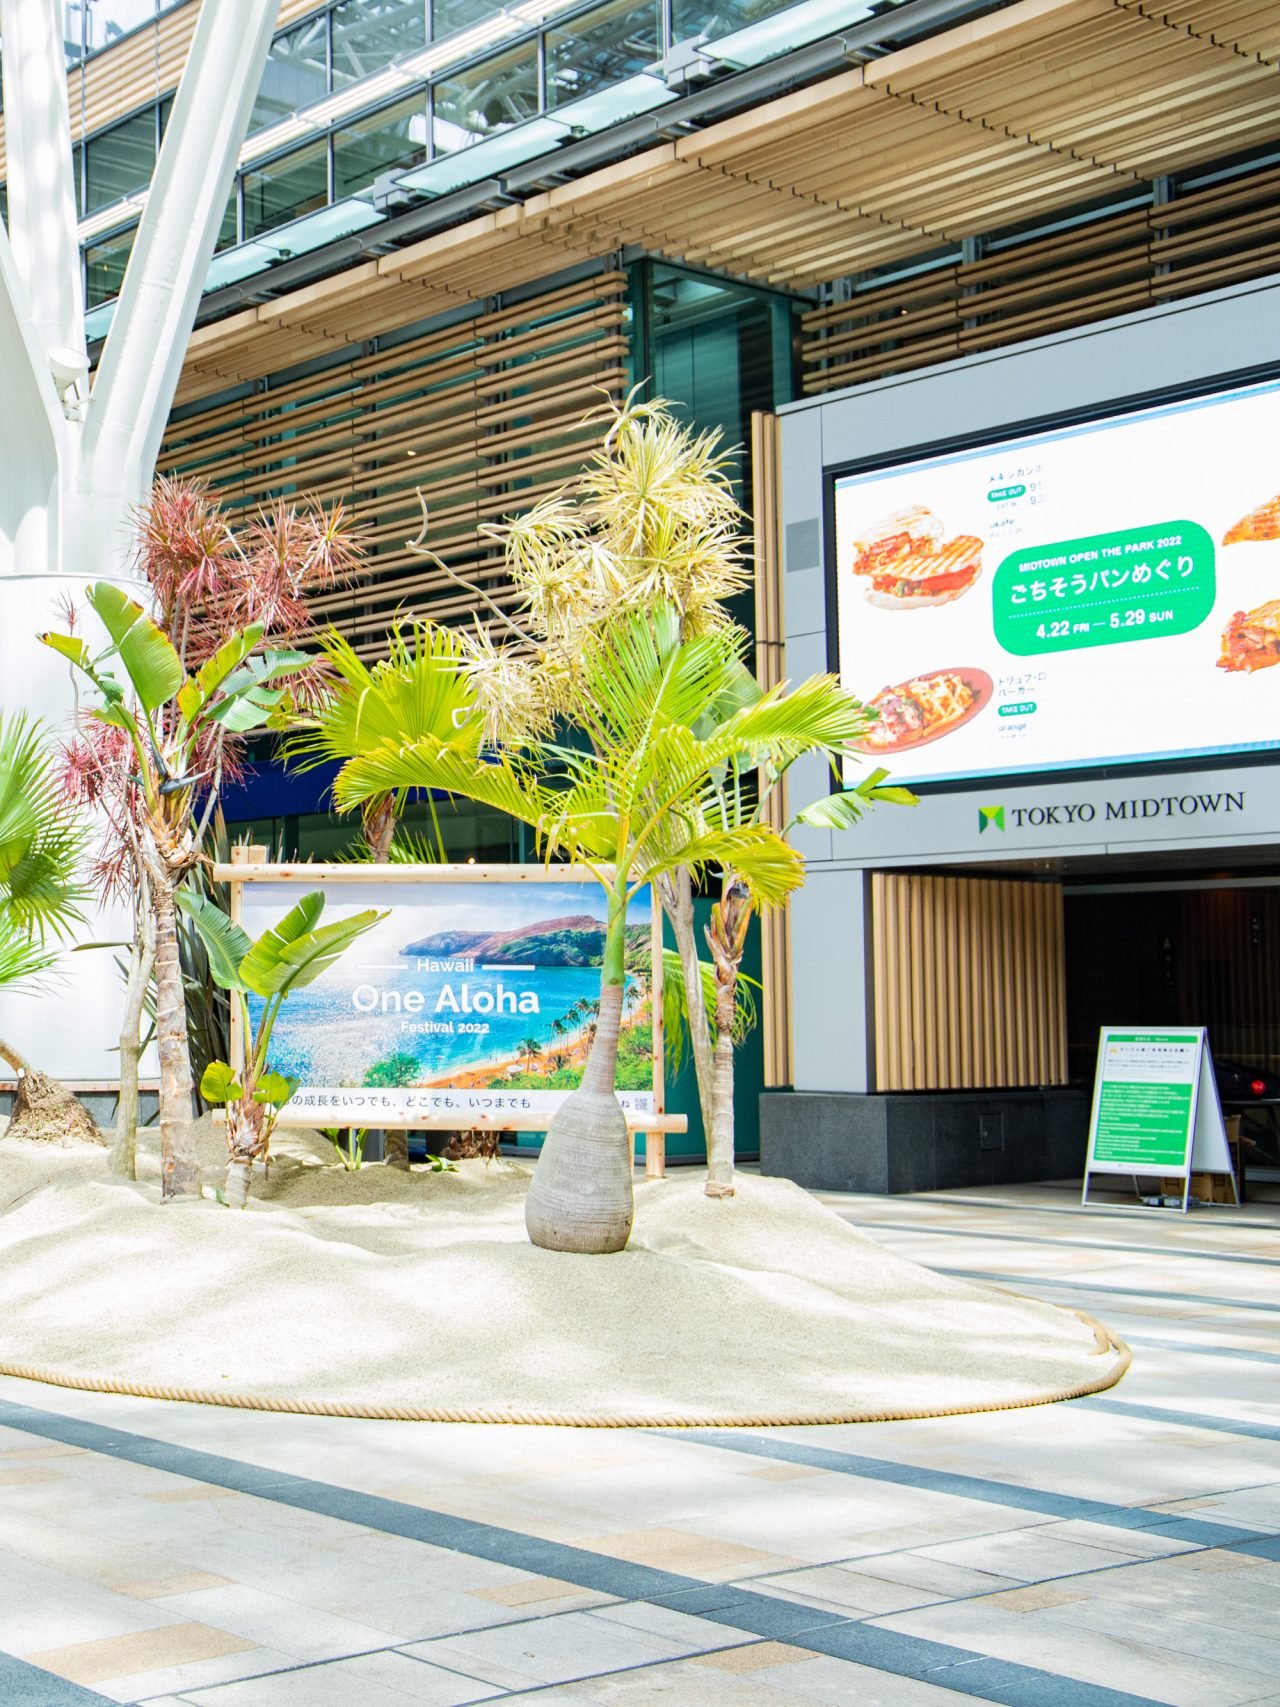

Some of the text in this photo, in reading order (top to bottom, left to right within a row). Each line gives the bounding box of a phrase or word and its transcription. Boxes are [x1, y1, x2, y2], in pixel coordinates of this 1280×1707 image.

[1019, 535, 1182, 573] MIDTOWN OPEN THE PARK 2022
[1010, 555, 1194, 605] ごちそうパンめぐり
[1035, 608, 1174, 639] 4.22 FRI 5.29 SUN
[1020, 703, 1034, 712] OUT
[1012, 791, 1246, 827] TOKYO MIDTOWN
[417, 958, 474, 973] Hawaii
[352, 984, 540, 1014] One Aloha
[400, 1021, 490, 1034] Festival 2022
